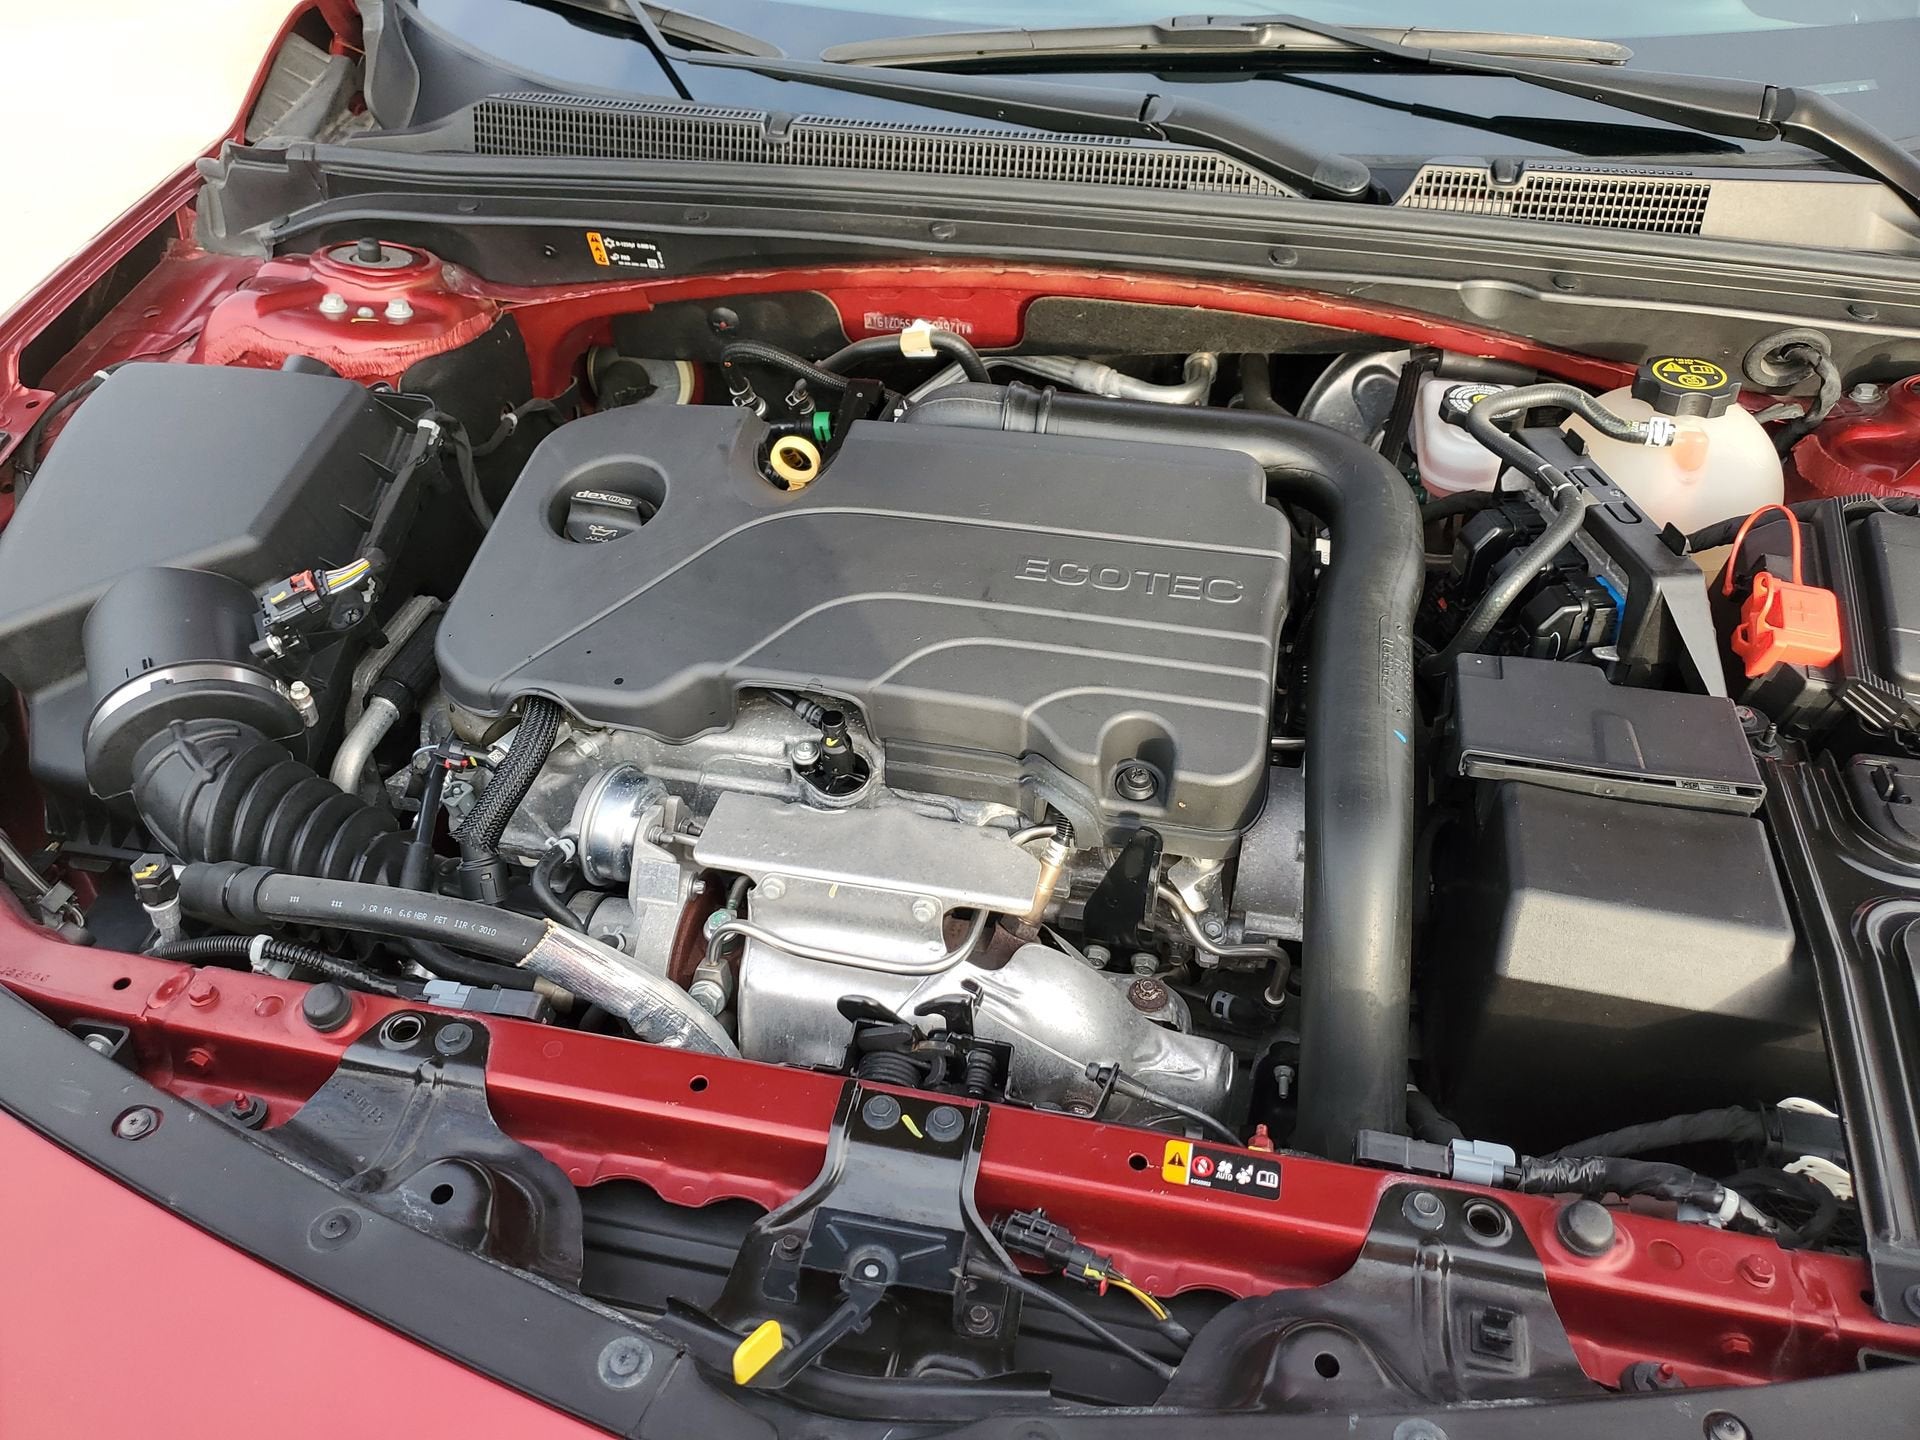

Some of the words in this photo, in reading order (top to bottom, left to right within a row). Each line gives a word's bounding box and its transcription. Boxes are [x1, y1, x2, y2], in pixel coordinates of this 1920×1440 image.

[1014, 555, 1245, 604] ECOTEC
[398, 909, 413, 919] 6.6
[433, 914, 448, 925] PET
[1215, 1172, 1234, 1182] AUTO
